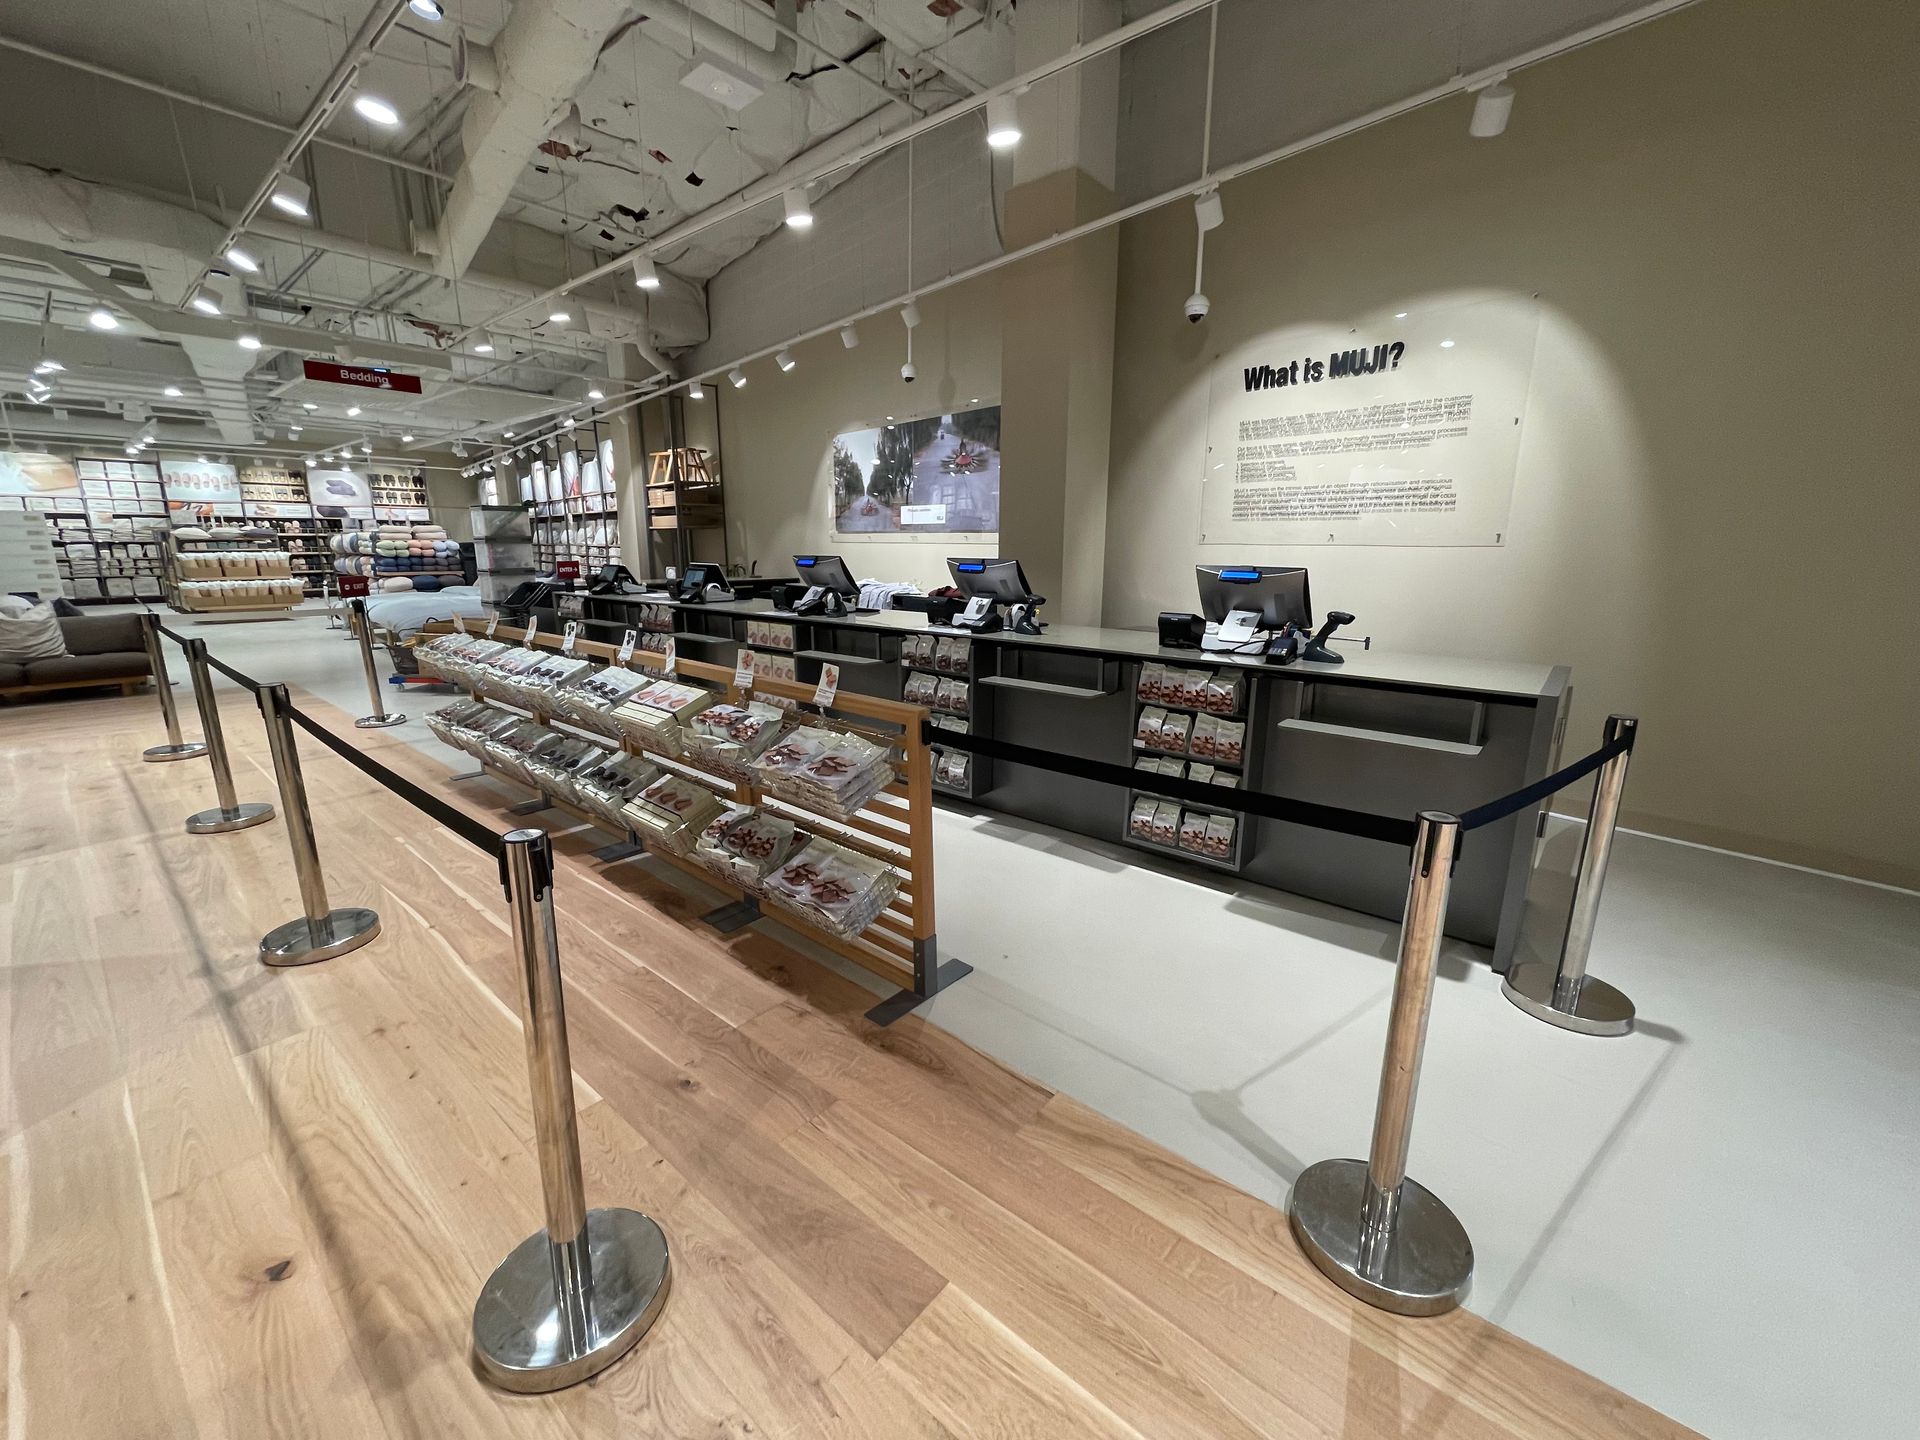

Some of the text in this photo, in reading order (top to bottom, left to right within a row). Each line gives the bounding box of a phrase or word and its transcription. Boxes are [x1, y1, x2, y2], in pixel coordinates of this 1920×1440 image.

[340, 370, 389, 384] Bedding
[1244, 342, 1405, 392] What is MUJI?
